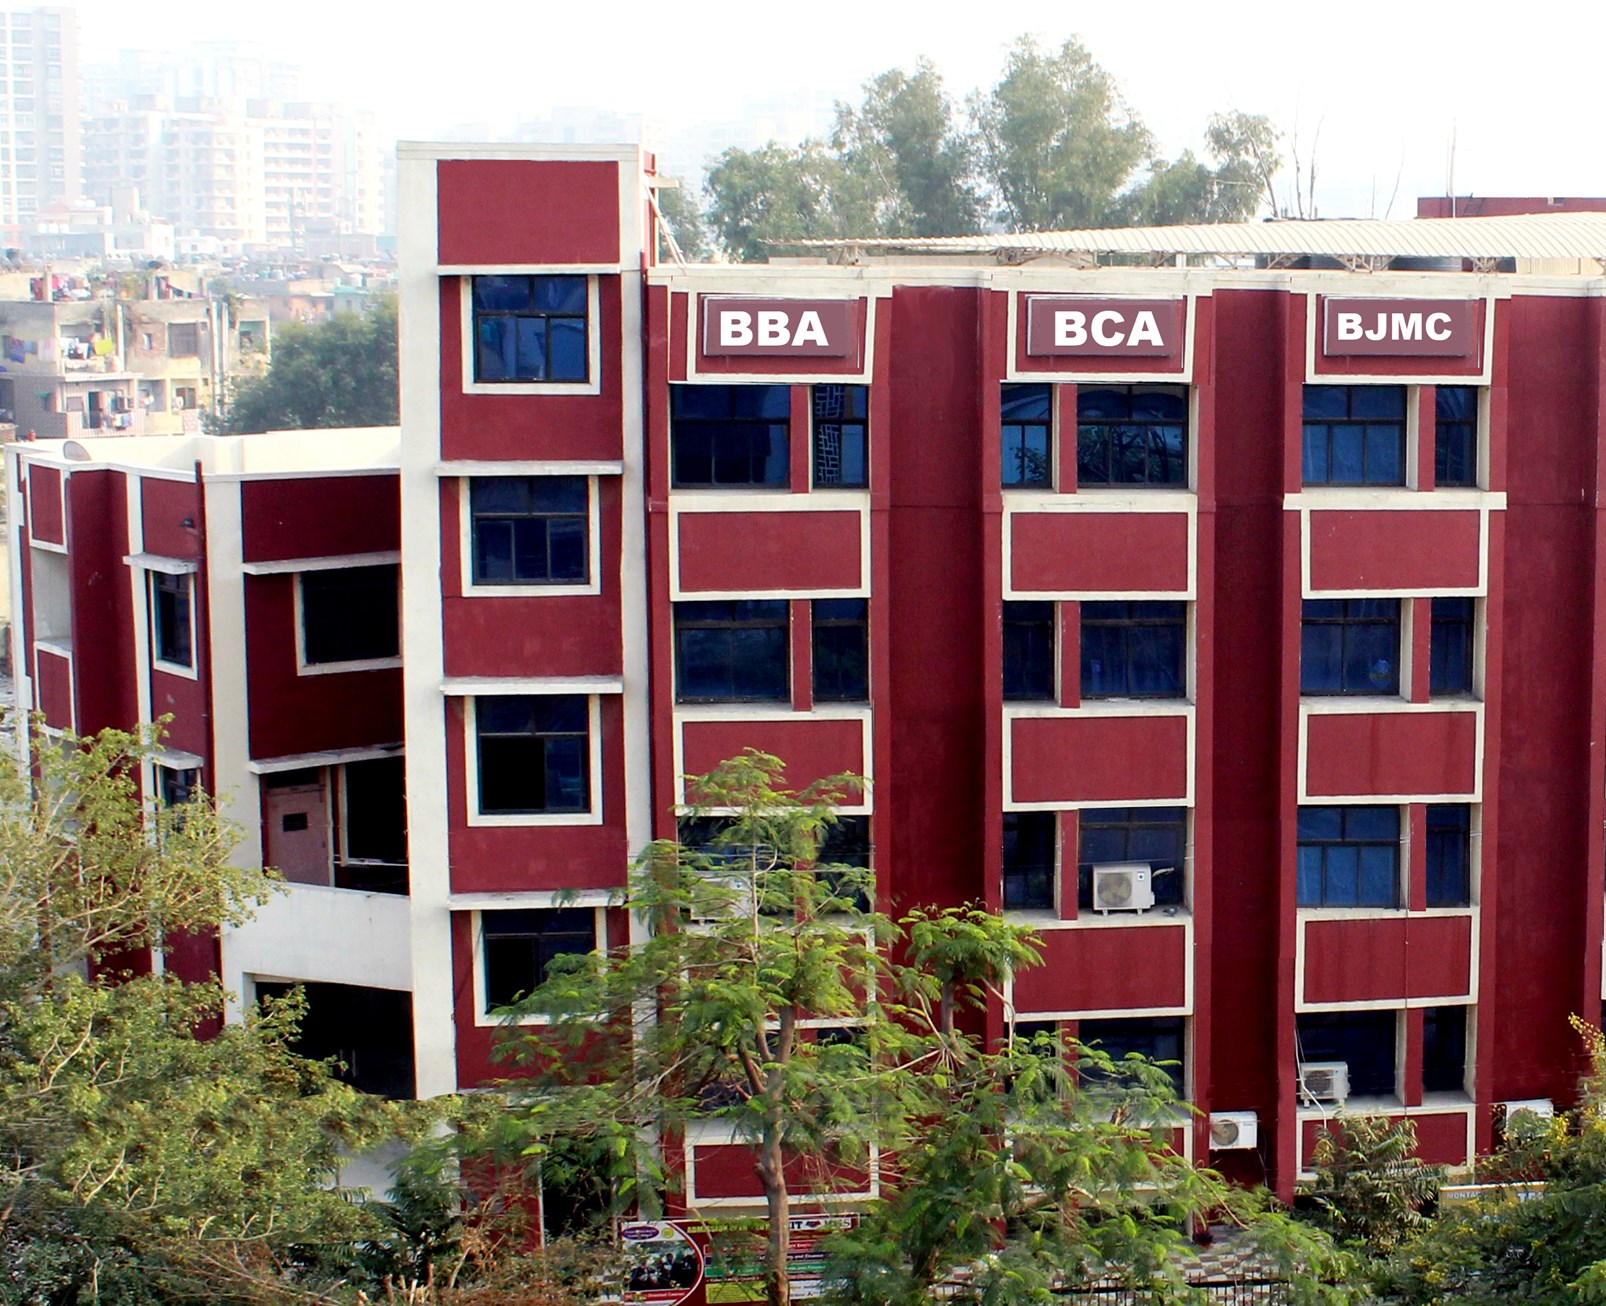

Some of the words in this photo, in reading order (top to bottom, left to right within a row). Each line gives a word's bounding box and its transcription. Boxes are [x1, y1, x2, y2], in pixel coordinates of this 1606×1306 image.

[720, 311, 829, 346] BBA
[1054, 311, 1164, 346] BCA
[1337, 312, 1452, 341] BJMC
